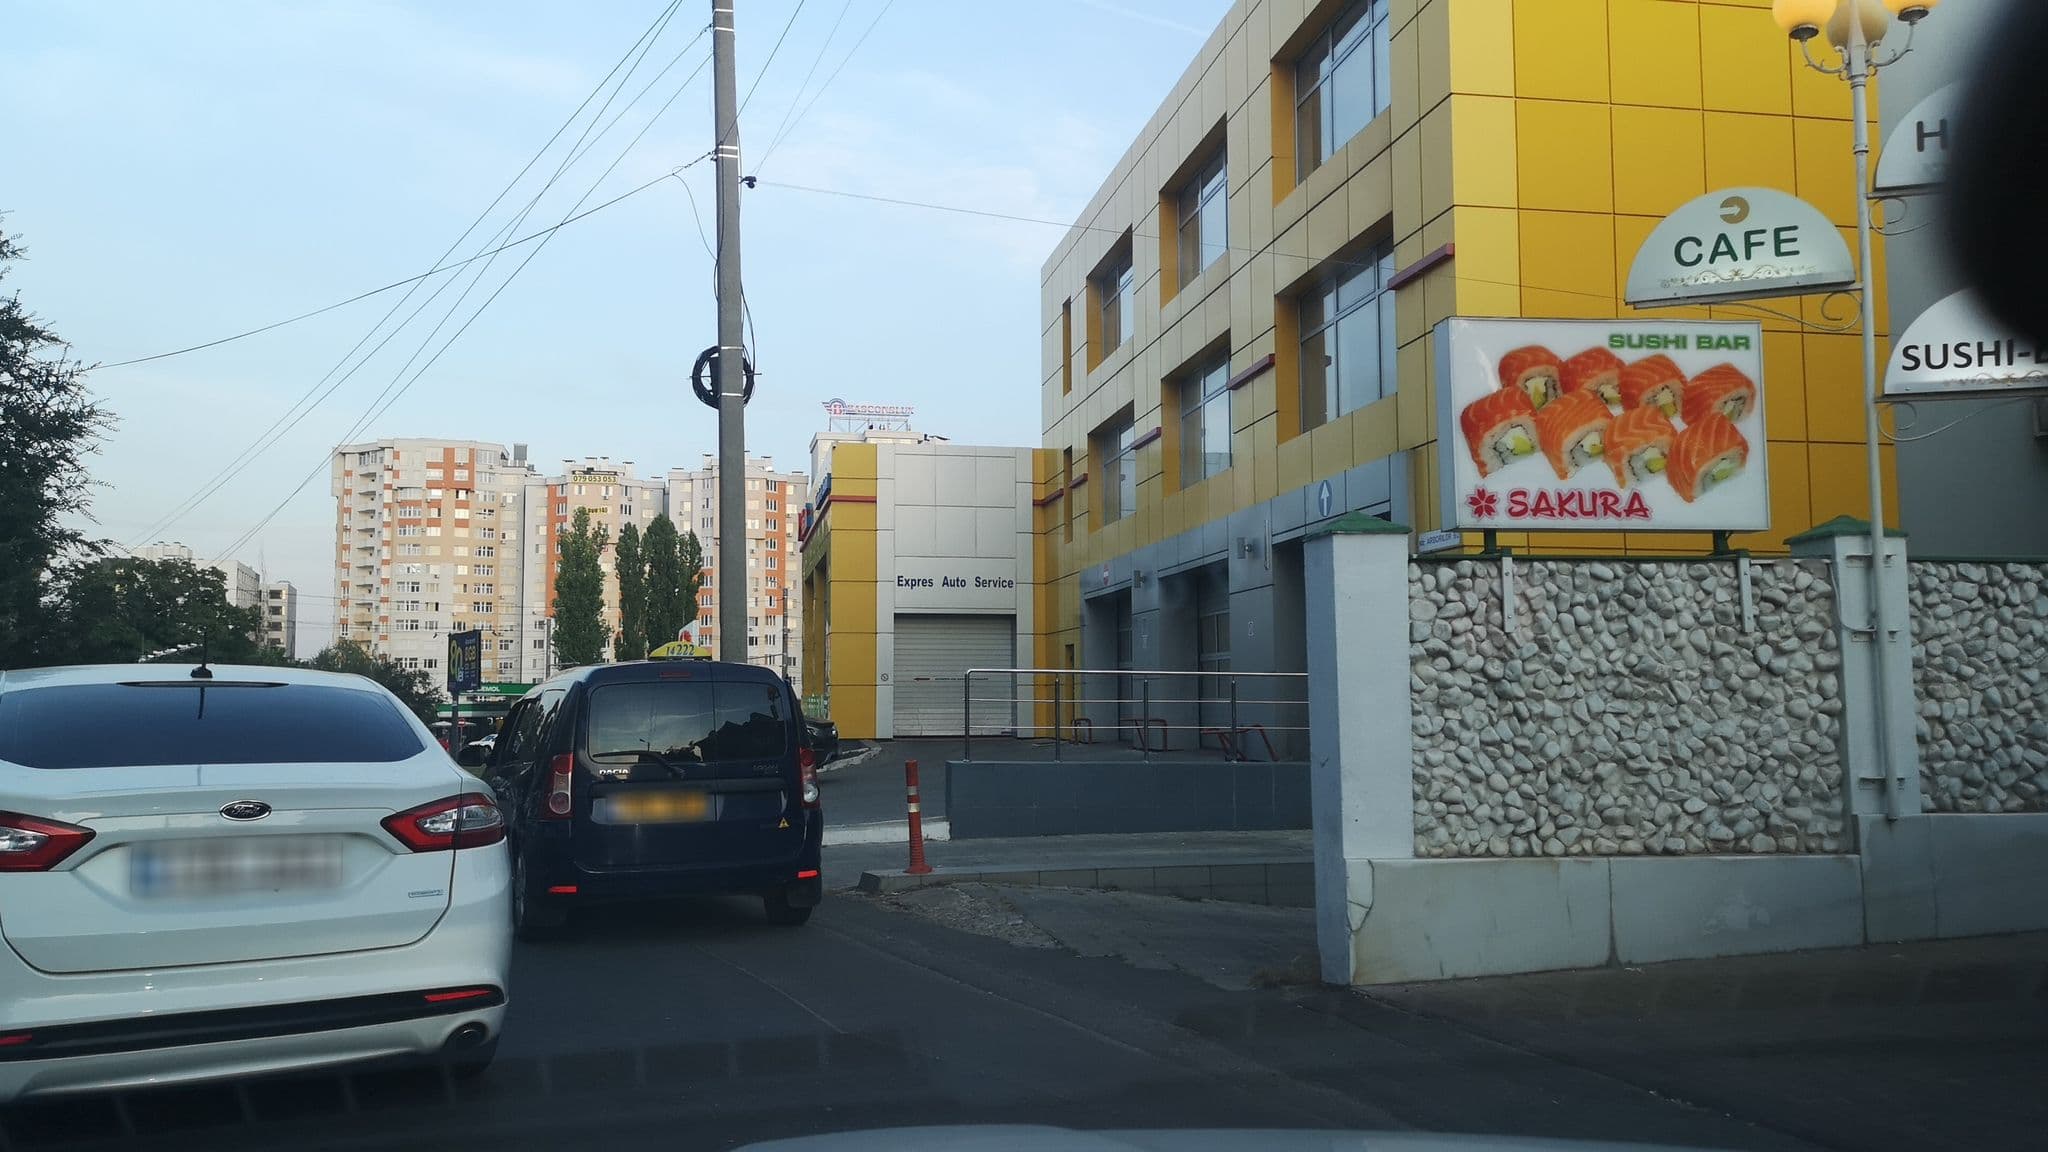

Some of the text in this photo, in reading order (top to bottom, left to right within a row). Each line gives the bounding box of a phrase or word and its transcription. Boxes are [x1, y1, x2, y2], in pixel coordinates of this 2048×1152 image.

[1674, 225, 1800, 267] CAFE
[1608, 333, 1751, 351] SUSHI BAR
[1507, 489, 1653, 519] SAKURA
[896, 575, 1014, 590] Expres Auto Service
